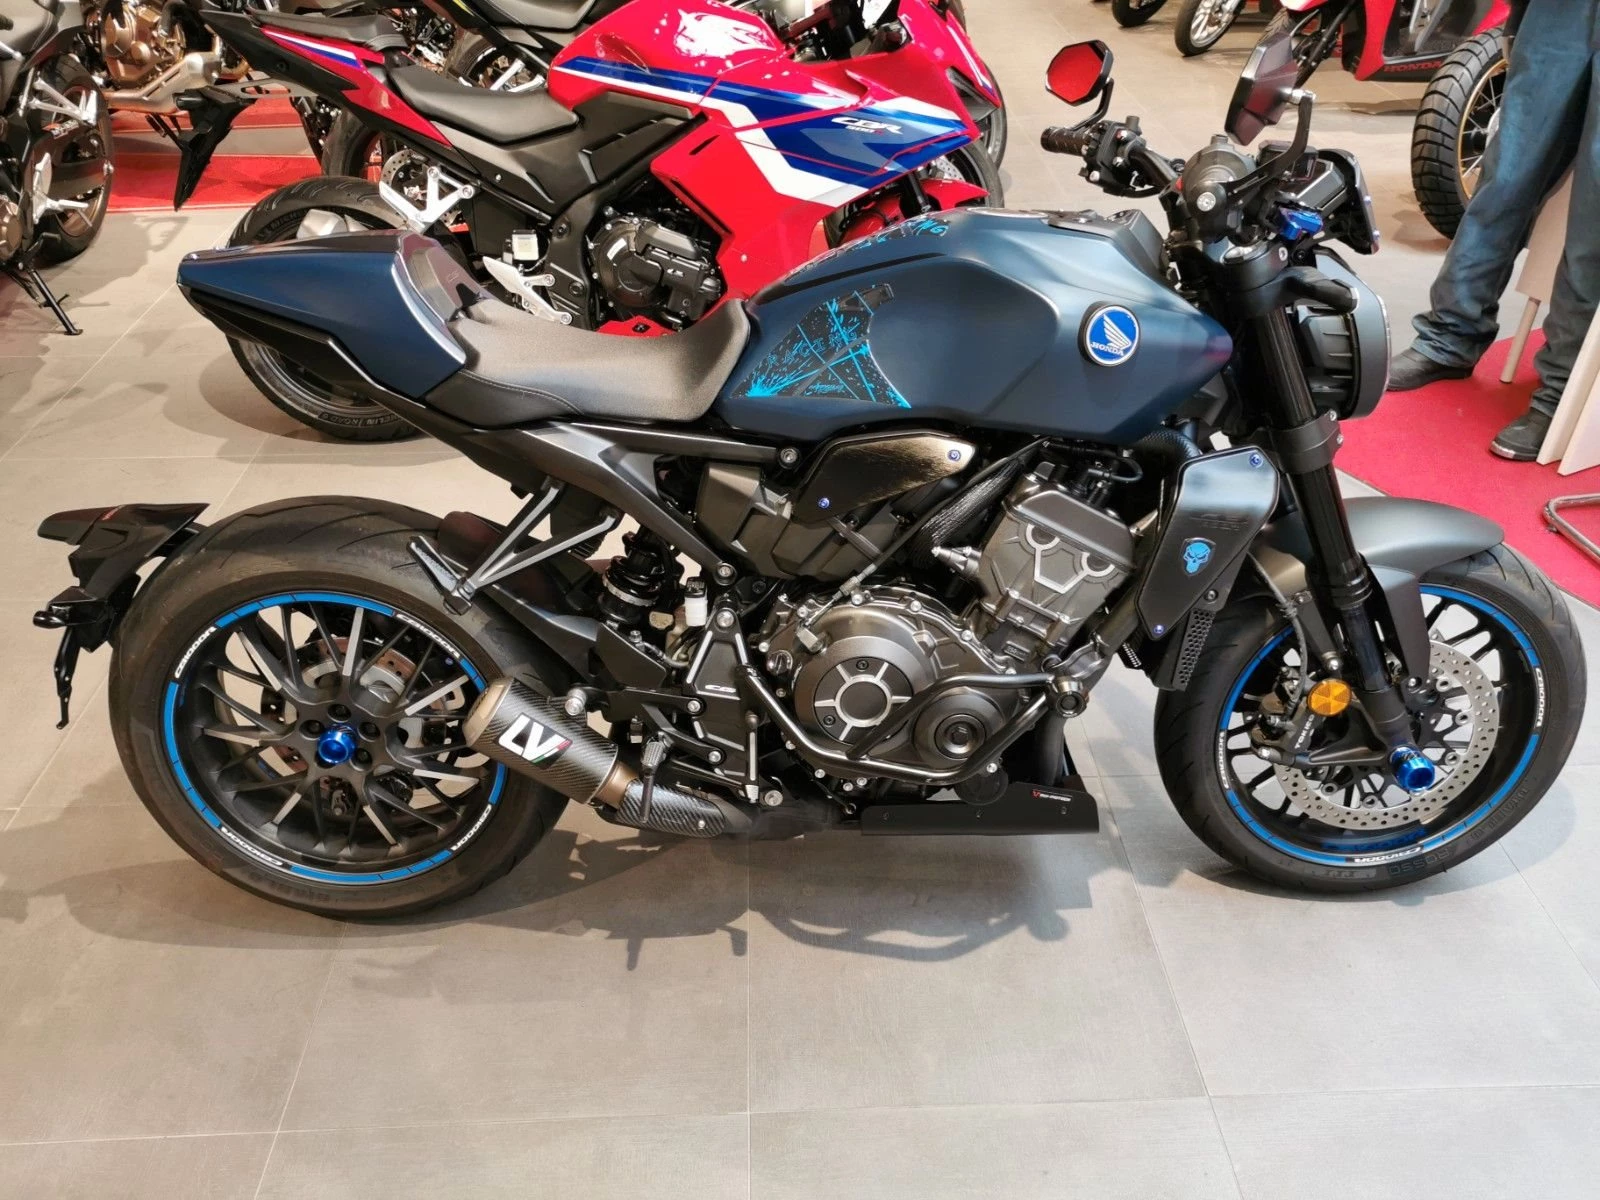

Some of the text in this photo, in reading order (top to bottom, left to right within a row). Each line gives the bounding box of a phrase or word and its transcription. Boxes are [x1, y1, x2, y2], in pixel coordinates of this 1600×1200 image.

[831, 116, 903, 135] CBR
[1090, 341, 1124, 356] HONDA
[174, 626, 217, 679] CB1000R
[396, 613, 460, 659] CB1000R
[1535, 667, 1545, 727] CB1000R
[498, 714, 567, 761] LV
[450, 803, 492, 851] CB1000R
